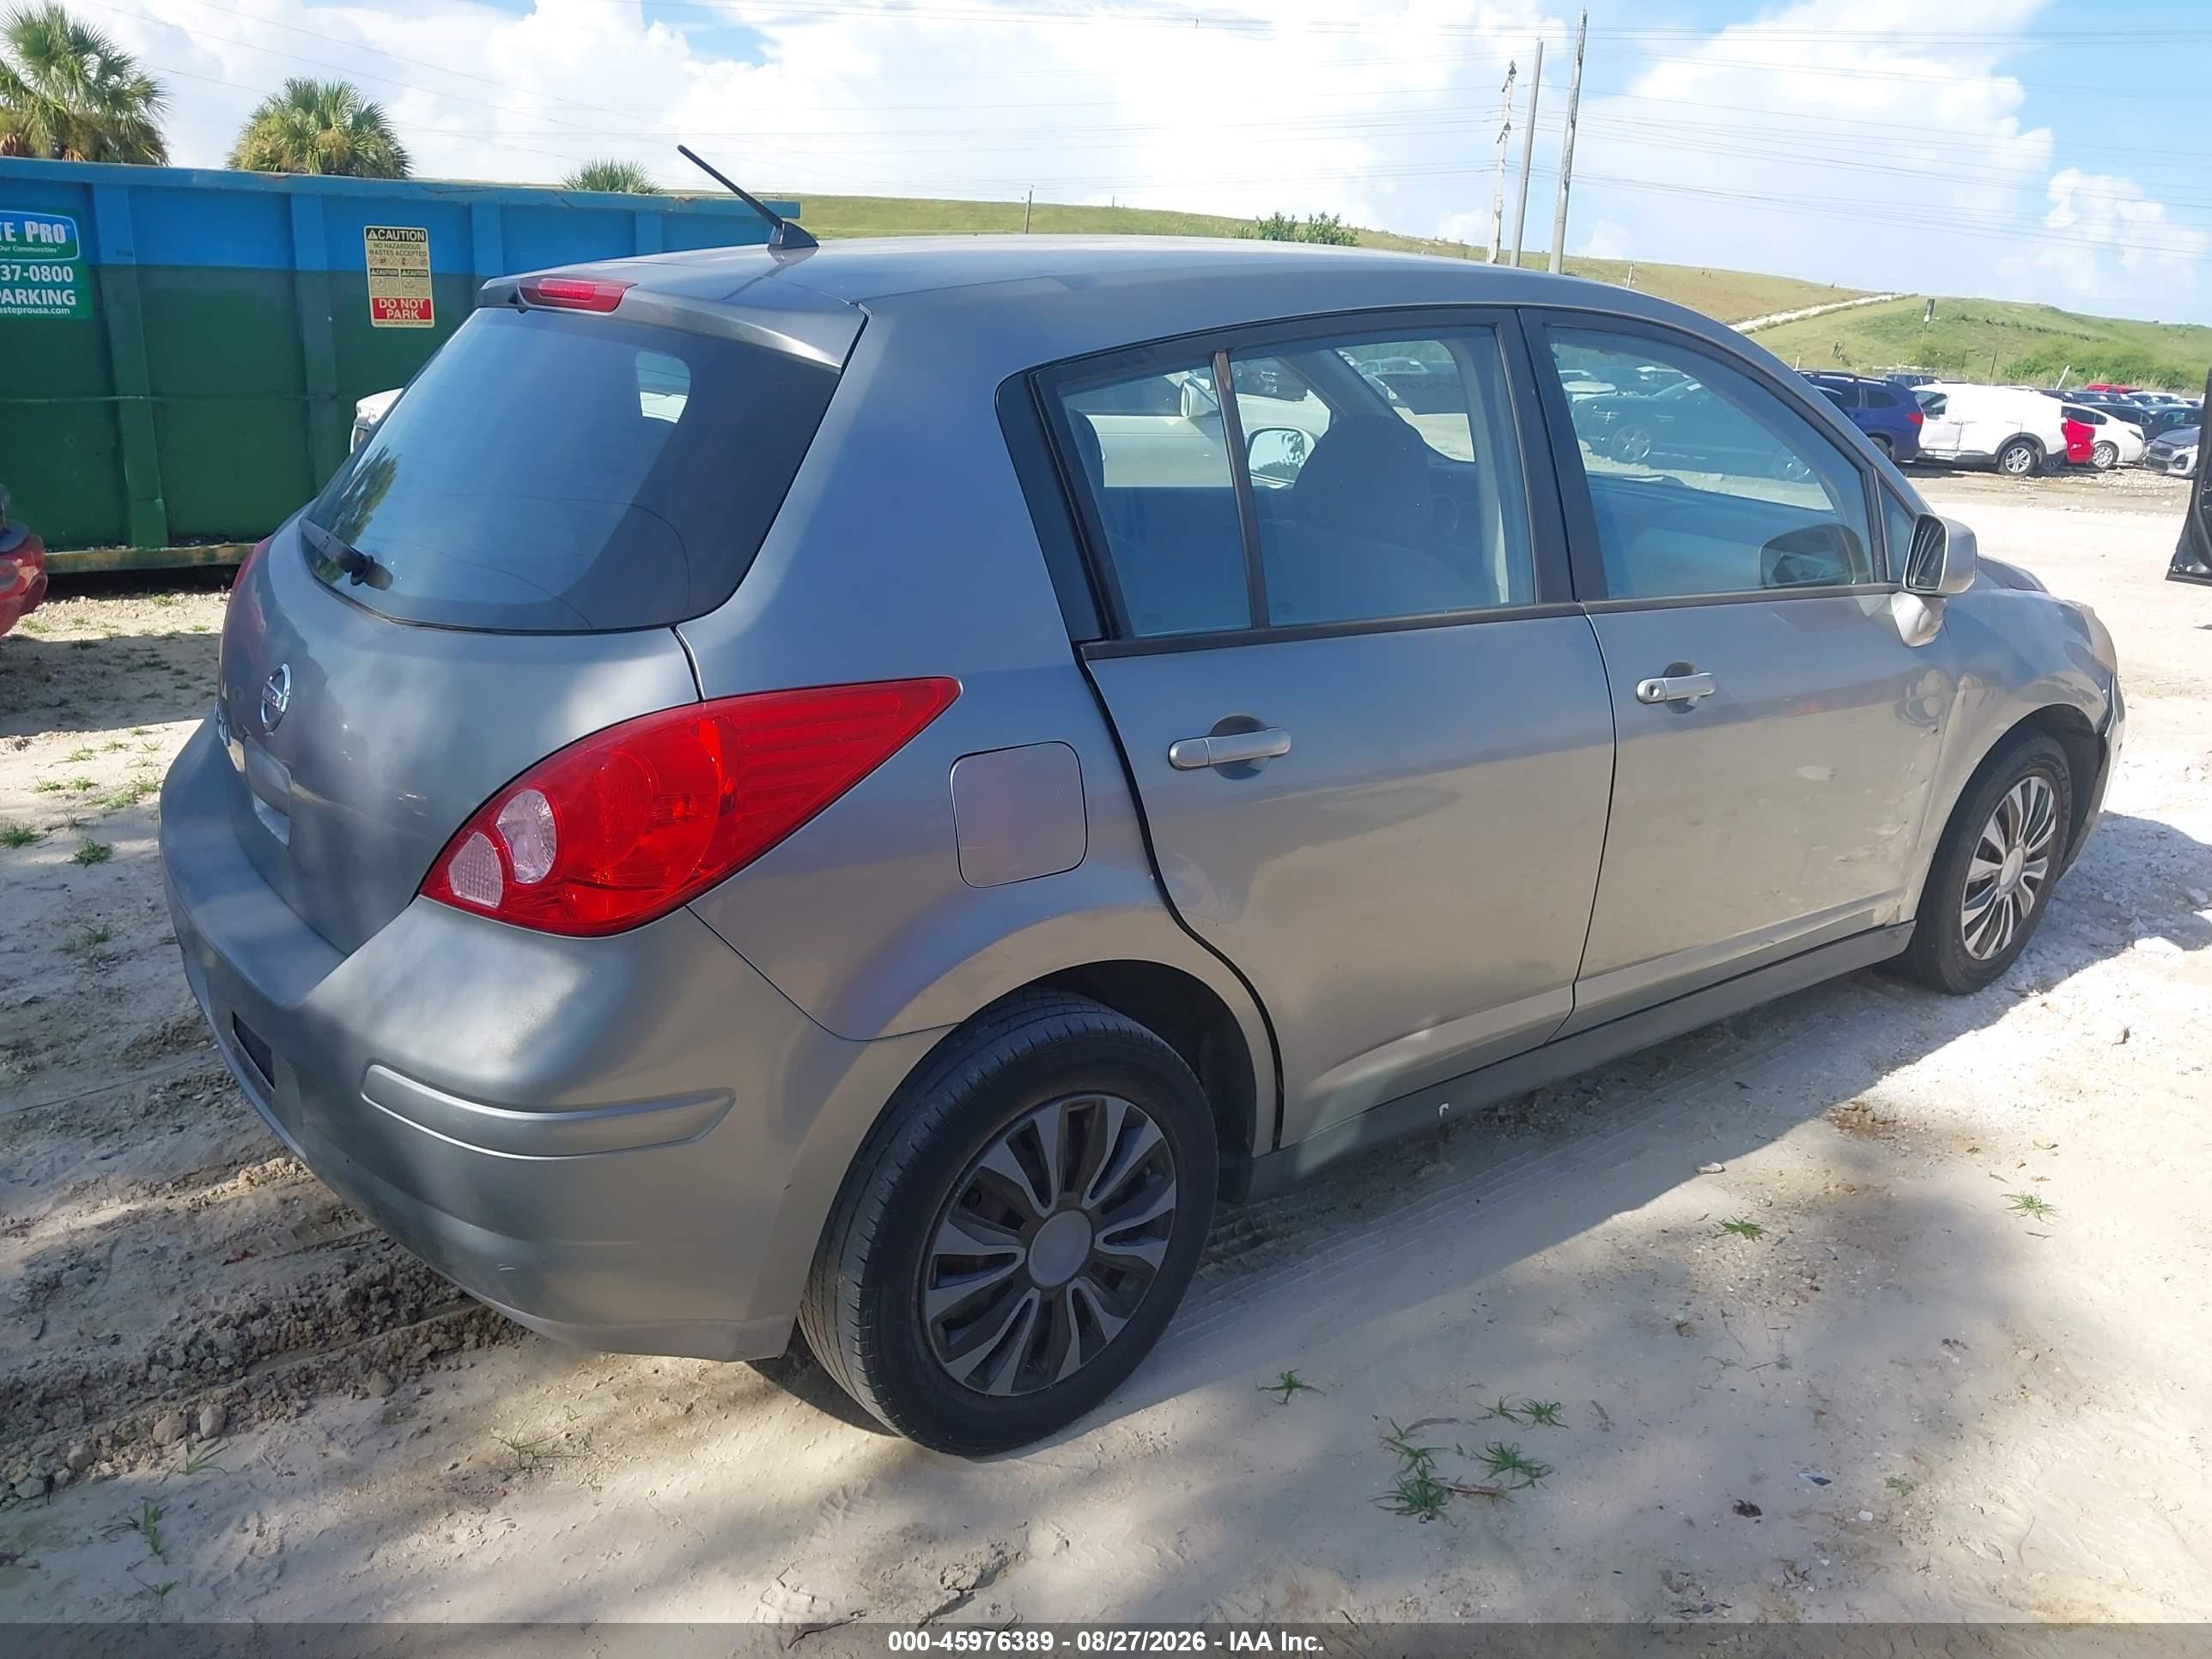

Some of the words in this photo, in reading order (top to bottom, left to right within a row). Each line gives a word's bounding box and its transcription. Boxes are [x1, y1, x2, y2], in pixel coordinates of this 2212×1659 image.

[25, 221, 66, 244] PRO
[378, 229, 425, 241] CAUTION
[0, 289, 76, 305] ARKING
[379, 299, 397, 309] DO
[400, 299, 425, 309] NOT
[386, 309, 420, 319] PARK
